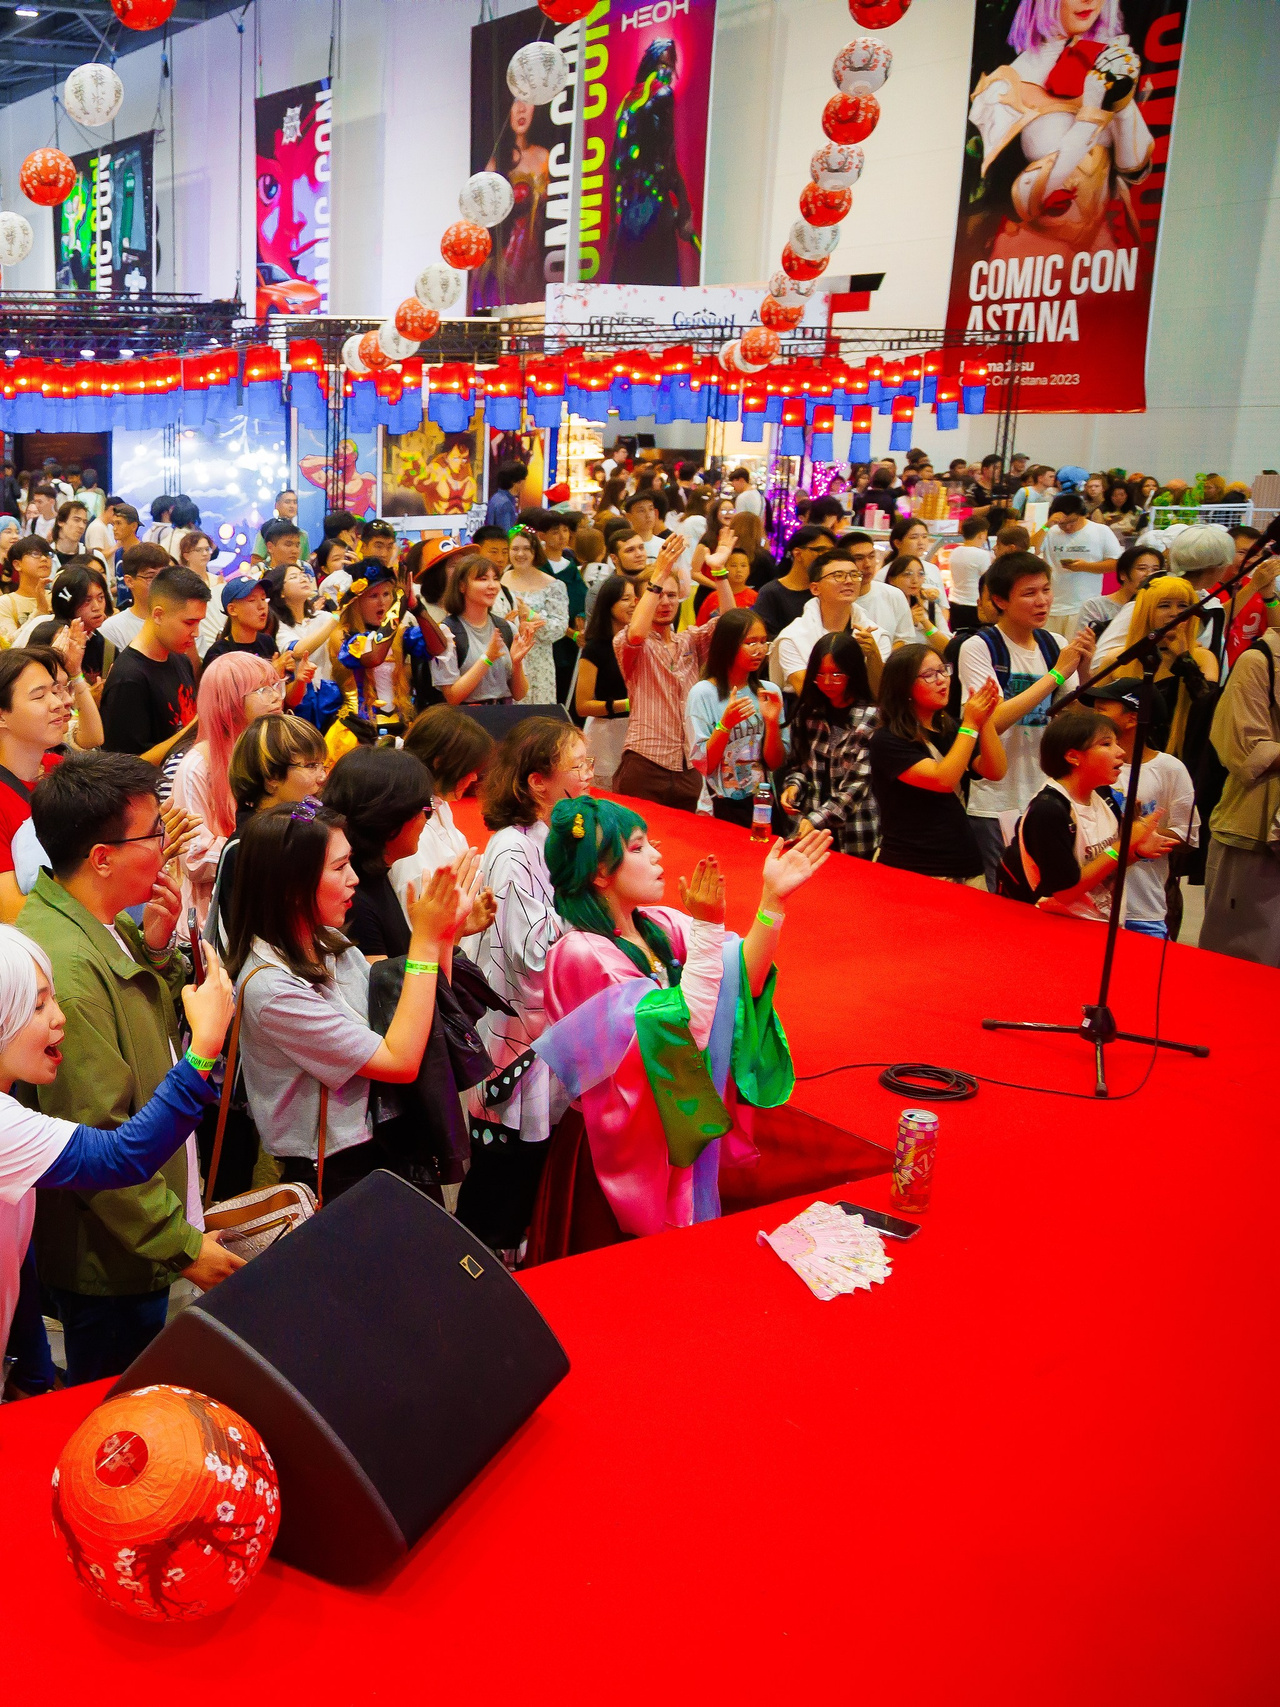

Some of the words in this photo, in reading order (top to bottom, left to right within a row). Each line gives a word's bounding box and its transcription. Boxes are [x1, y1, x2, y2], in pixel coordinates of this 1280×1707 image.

[968, 254, 1064, 302] COMIC
[1070, 247, 1139, 296] CON
[963, 299, 1080, 347] ASTANA
[1049, 374, 1080, 386] 2023
